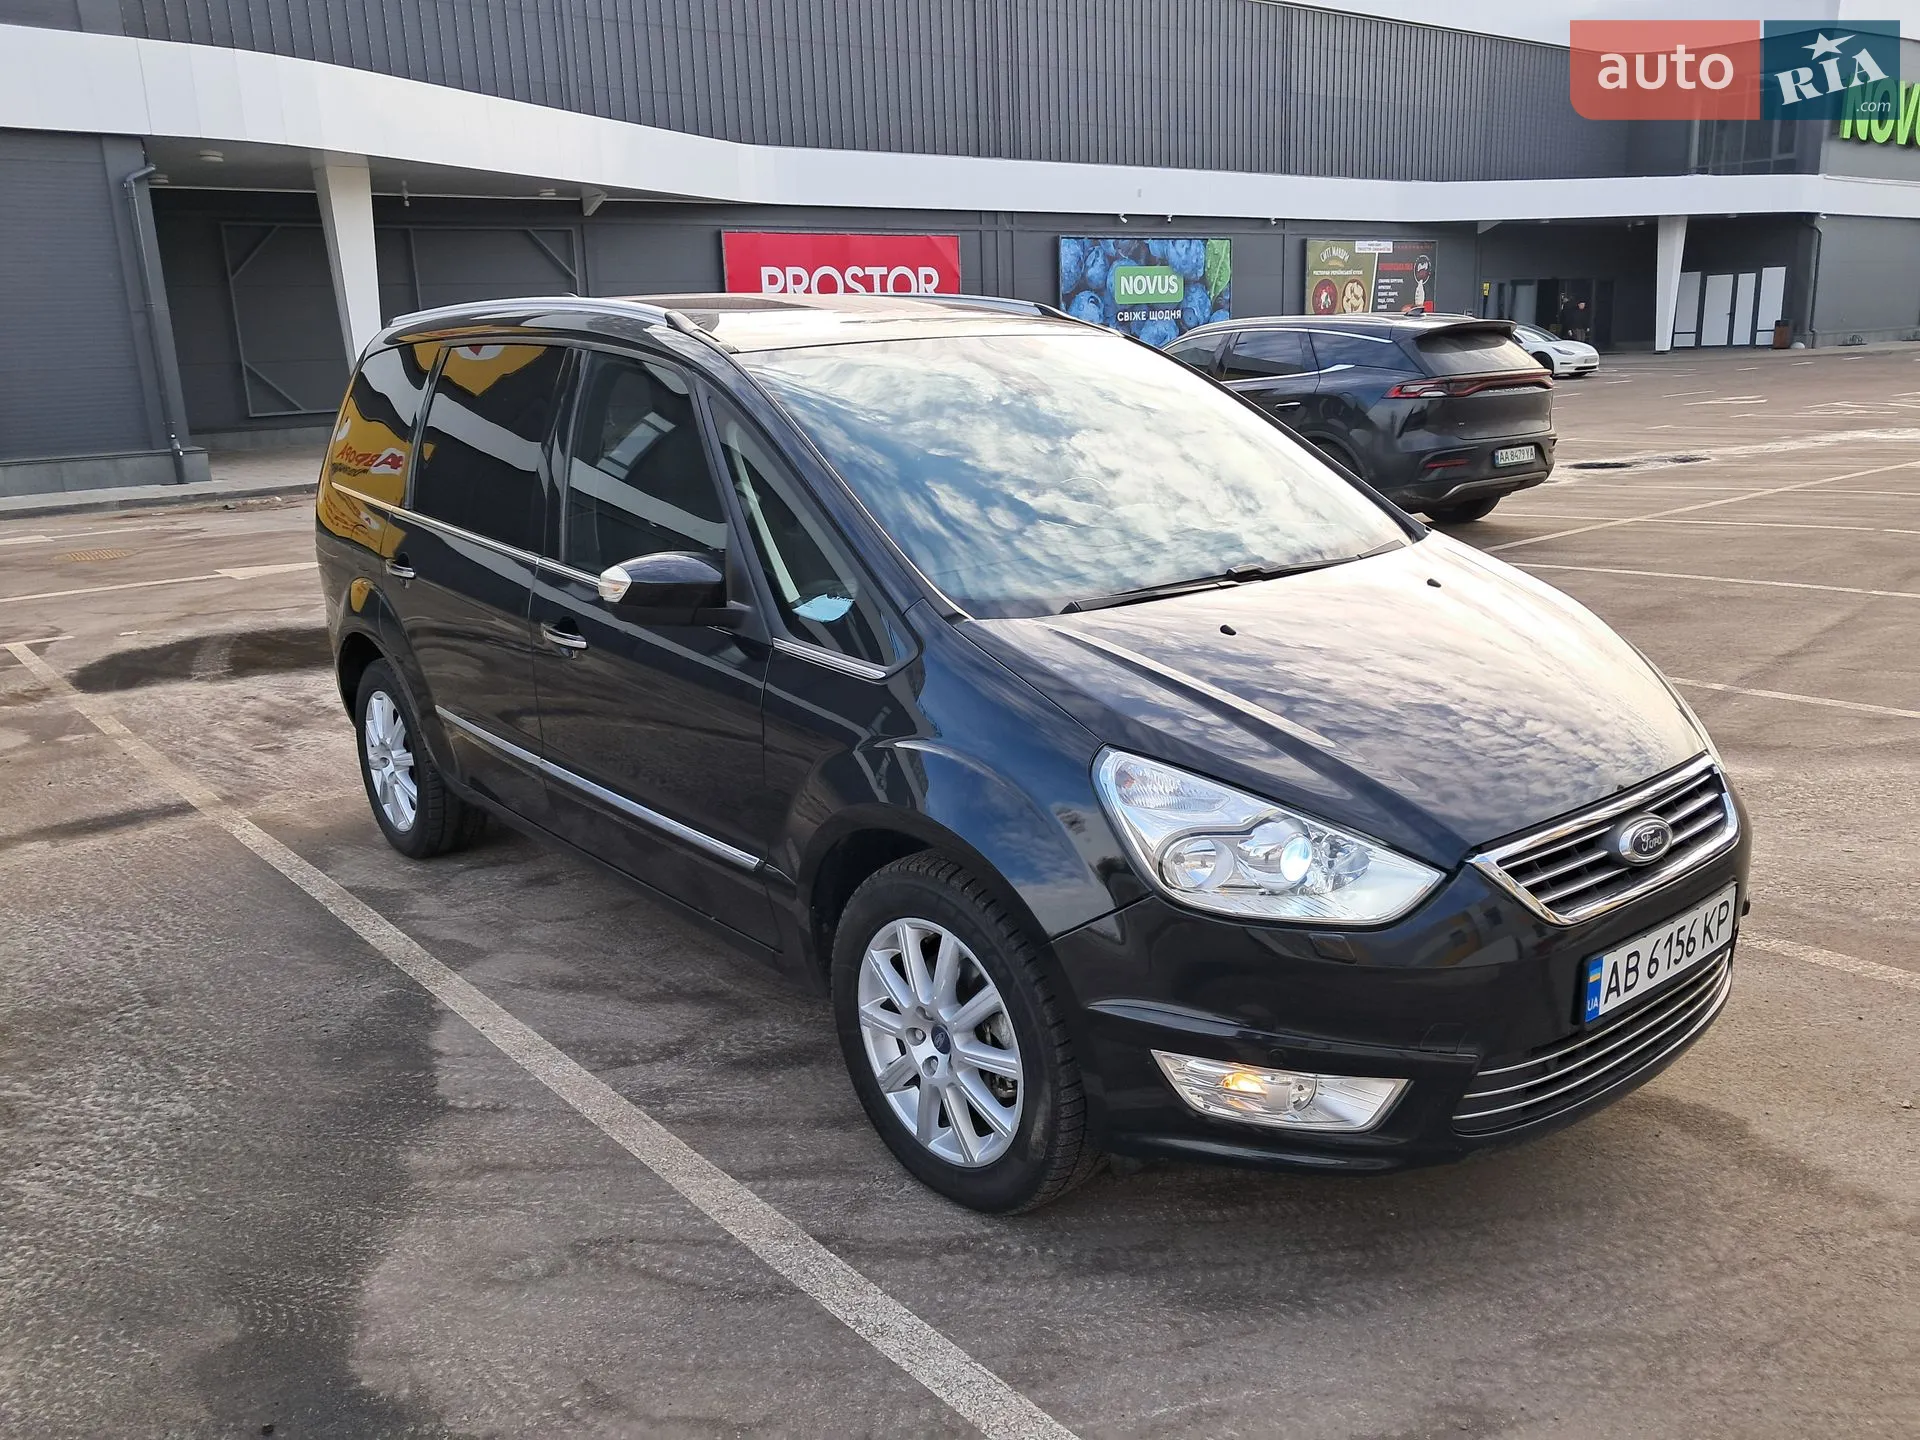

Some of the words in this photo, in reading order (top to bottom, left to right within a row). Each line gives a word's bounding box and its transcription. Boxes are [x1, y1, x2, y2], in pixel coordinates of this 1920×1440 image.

[1840, 72, 1920, 146] NOV
[760, 265, 940, 295] PROSTOR
[1120, 274, 1179, 295] NOVUS
[1117, 311, 1147, 322] СВІЖЕ
[1149, 309, 1182, 321] ЩОДНЯ
[1641, 829, 1663, 852] Ford
[1604, 950, 1641, 1005] AB
[1647, 918, 1699, 980] 6156
[1702, 900, 1730, 950] KP
[1587, 997, 1600, 1012] UA
